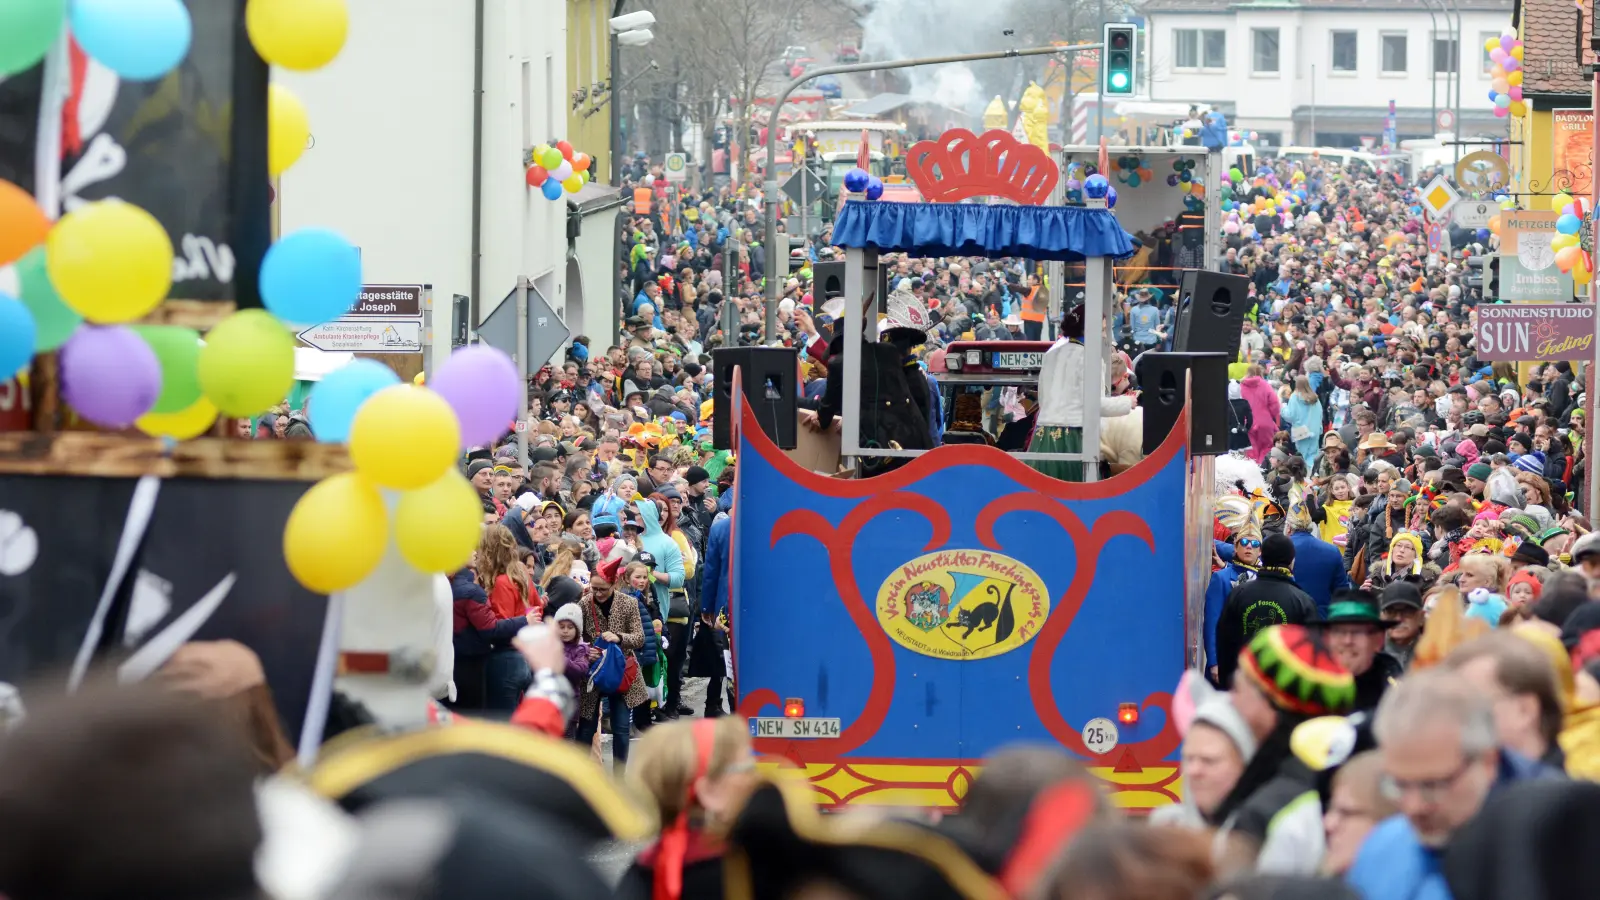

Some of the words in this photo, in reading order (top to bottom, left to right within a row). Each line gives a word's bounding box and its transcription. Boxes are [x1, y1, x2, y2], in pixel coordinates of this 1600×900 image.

[1508, 219, 1557, 229] METZGER
[1516, 273, 1558, 284] Imbiss
[1510, 285, 1562, 296] Partyservice
[359, 302, 397, 313] Joseph
[1481, 307, 1593, 319] SONNENSTUDIO
[342, 333, 380, 341] Krankenpflege
[1480, 321, 1530, 353] SUN
[1535, 333, 1594, 359] Feeling
[1000, 353, 1020, 366] NEW
[1029, 353, 1043, 366] SW
[885, 579, 906, 620] Verein
[903, 551, 978, 581] Neustädter
[978, 553, 1043, 619] Faschingszug
[895, 627, 927, 651] NEUSTADT
[758, 720, 783, 735] NEW
[793, 720, 811, 735] SW
[813, 721, 840, 735] 414
[1087, 727, 1104, 744] 25
